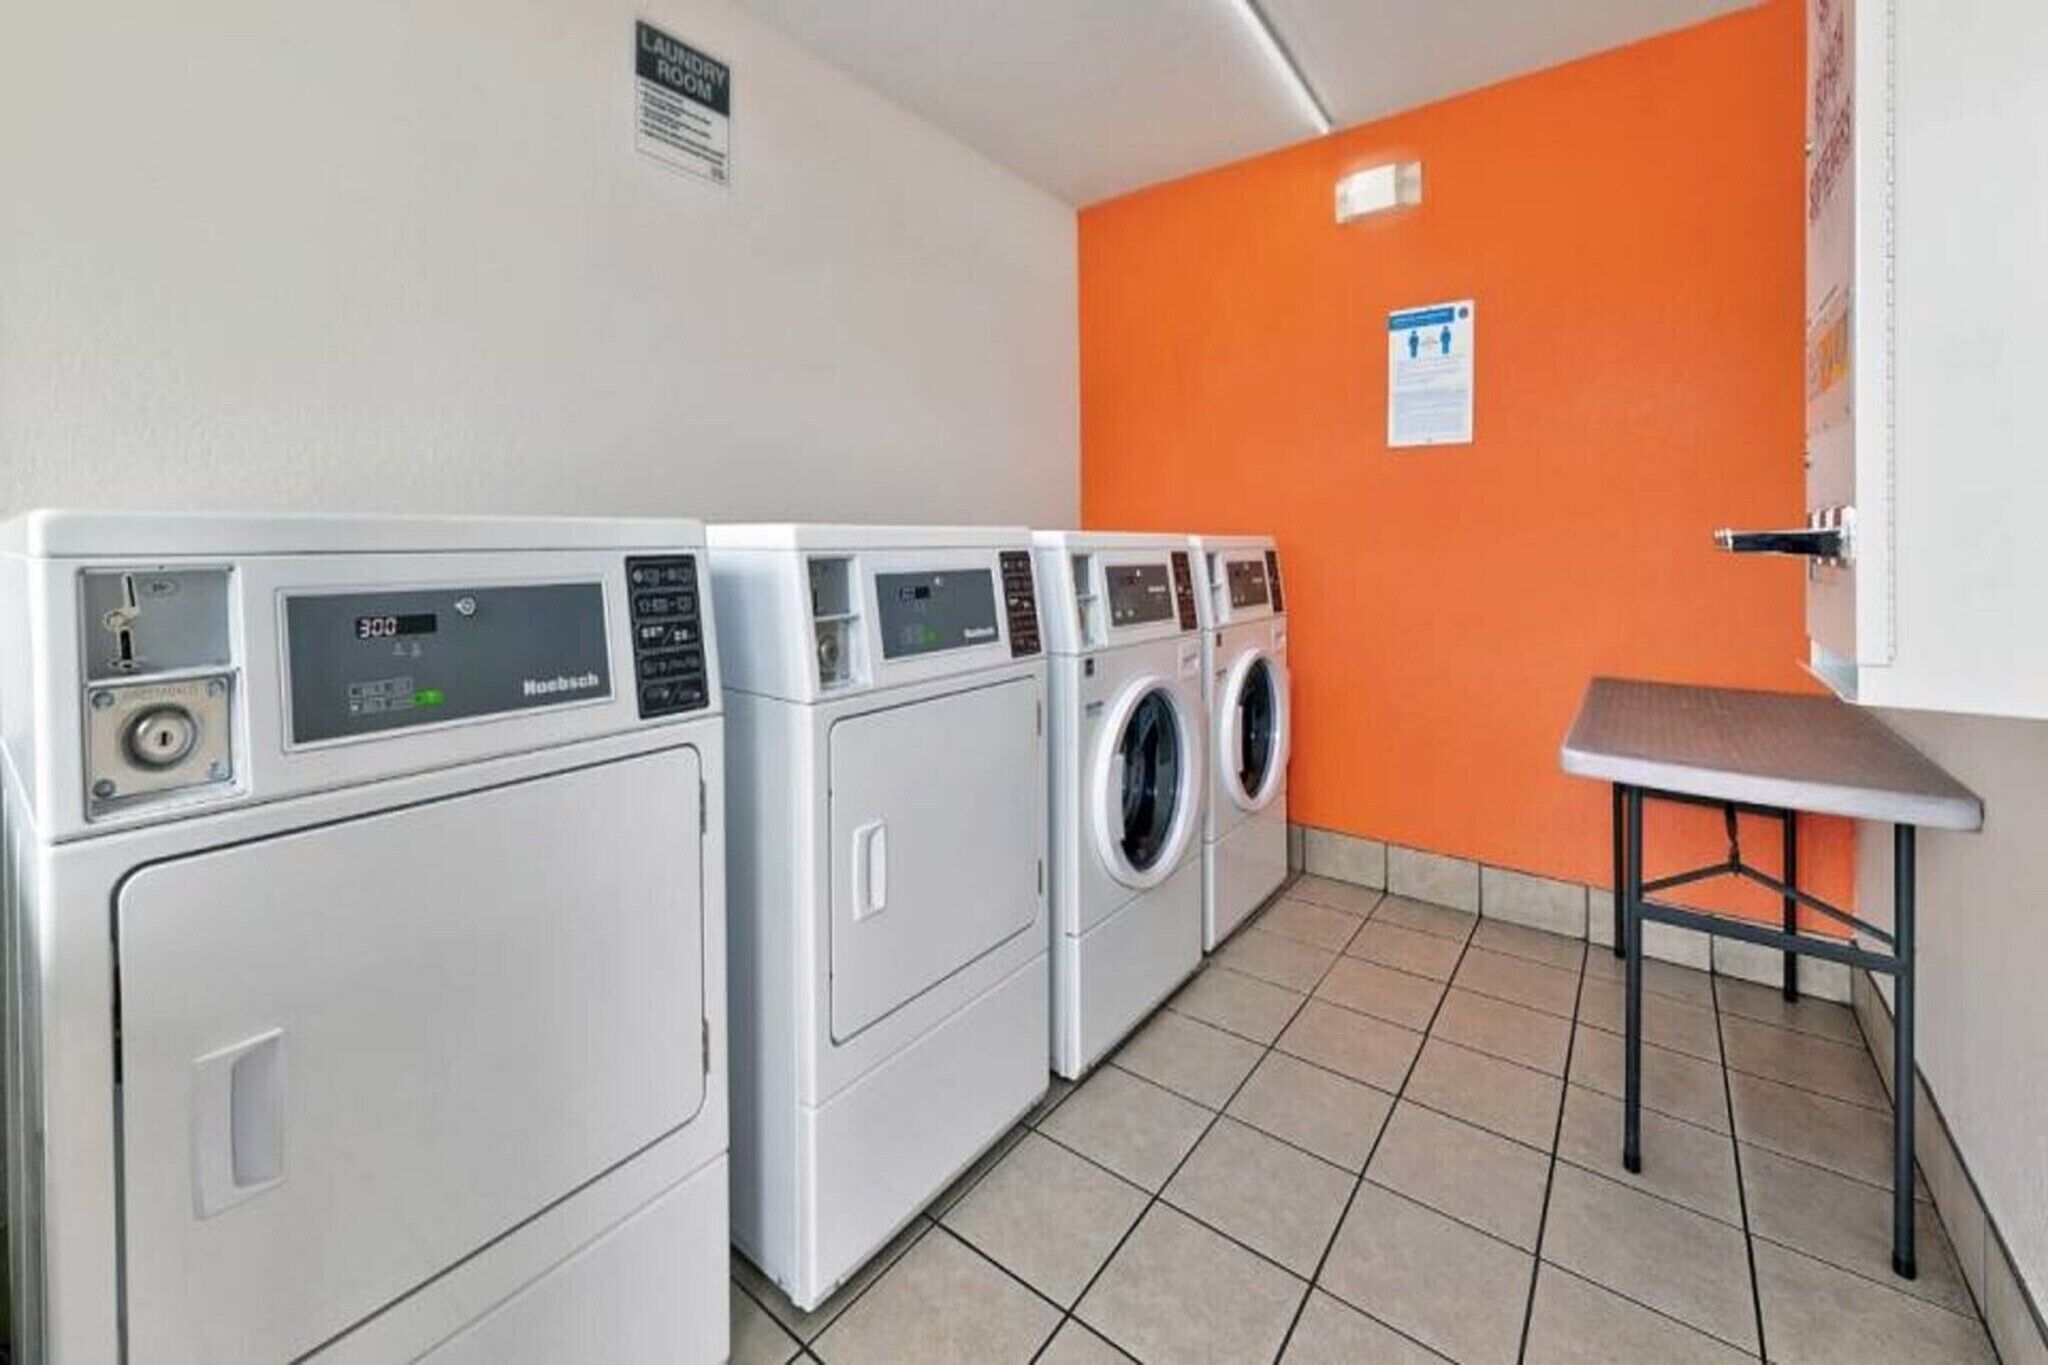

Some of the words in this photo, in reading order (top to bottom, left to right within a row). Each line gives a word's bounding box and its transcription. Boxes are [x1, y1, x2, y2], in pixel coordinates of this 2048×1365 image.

[641, 28, 726, 86] LAUNDRY
[657, 59, 712, 101] ROOM
[359, 617, 397, 638] 300
